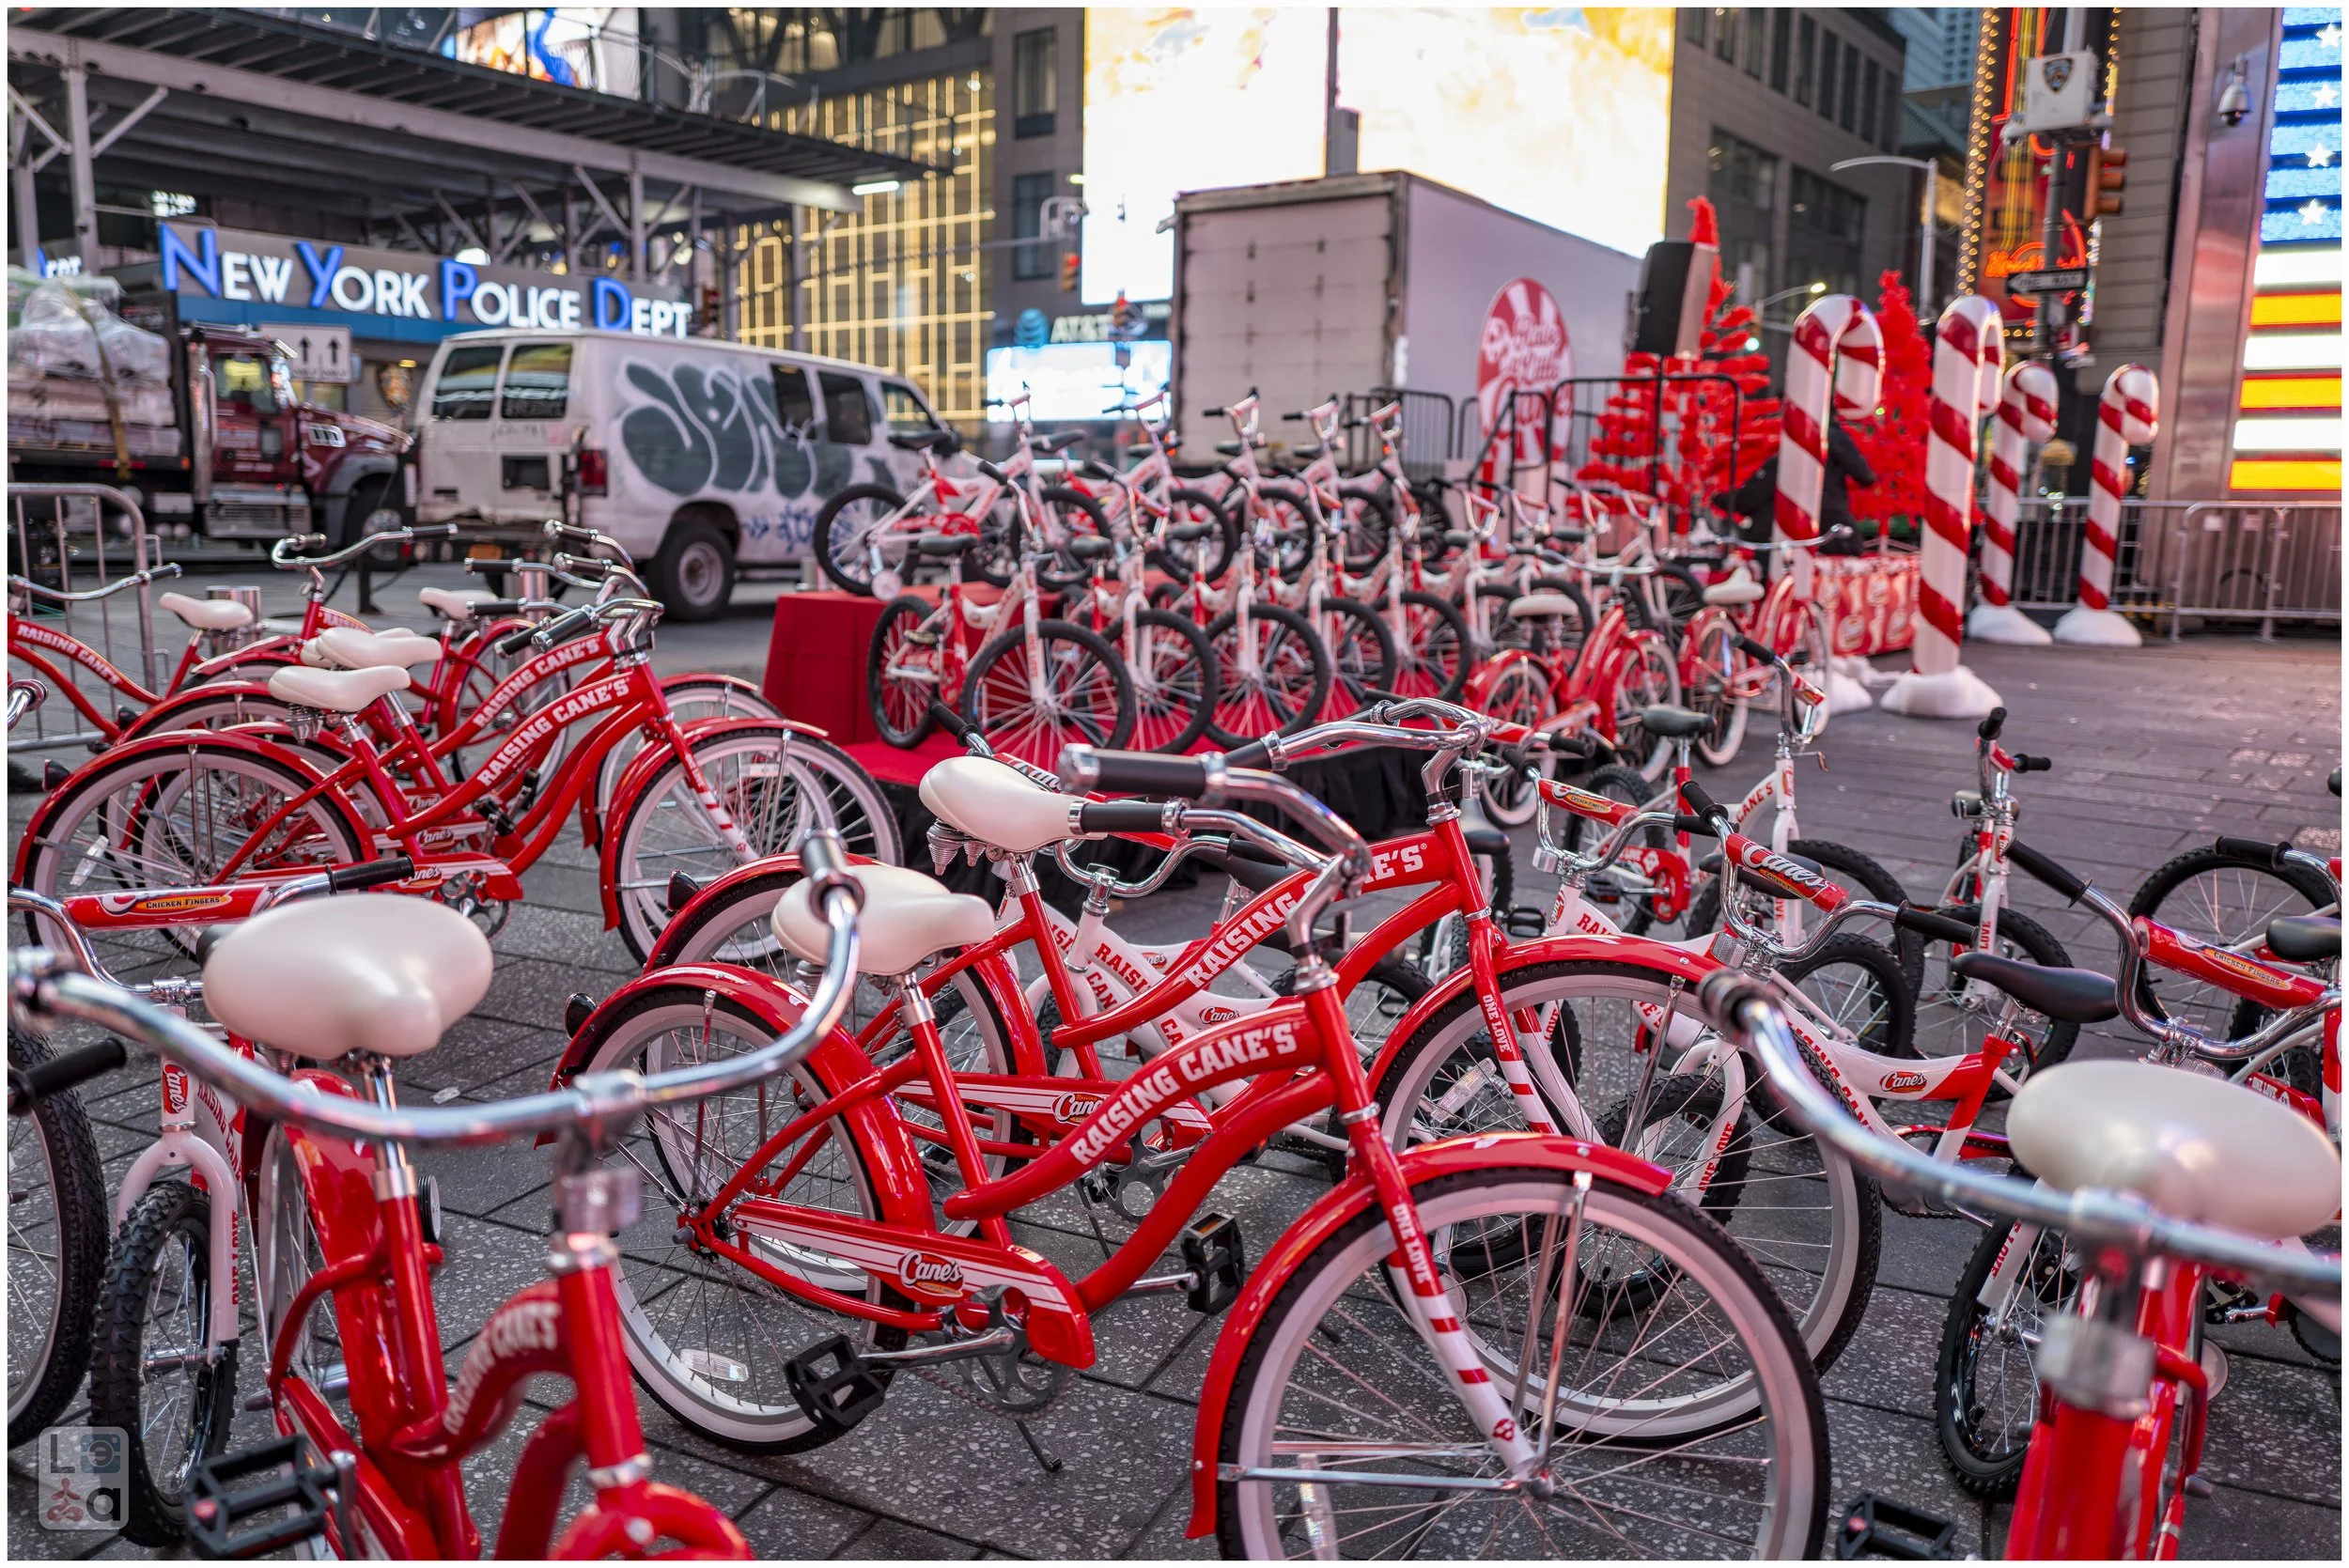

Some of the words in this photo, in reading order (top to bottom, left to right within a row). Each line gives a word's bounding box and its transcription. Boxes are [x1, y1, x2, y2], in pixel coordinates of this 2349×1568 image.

[160, 221, 293, 303] NEW
[296, 241, 431, 318] YORK
[442, 259, 581, 330] POLICE
[594, 277, 692, 339] DEPT
[17, 624, 77, 655] RAISING
[473, 669, 537, 729] RAISING
[535, 636, 599, 674] CANE'S
[476, 716, 553, 787] RAISING
[552, 677, 630, 723] CANE'S
[146, 900, 182, 909] CHICKEN
[184, 896, 221, 907] FINGERS
[1185, 893, 1299, 988] RAISING
[1980, 922, 1991, 951] LOVE
[2213, 951, 2247, 970] CHICKEN
[2248, 966, 2281, 986] FINGERS
[1086, 971, 1117, 1009] CAN
[1482, 993, 1498, 1021] ONE
[1490, 1017, 1512, 1053] LOVE
[1070, 1066, 1180, 1165] RAISING
[1178, 1022, 1297, 1082] CANE'S
[1881, 1071, 1927, 1093] Cane's
[1713, 1121, 1735, 1159] OVE
[1392, 1203, 1417, 1240] ONE
[1405, 1236, 1432, 1284] LOVE
[900, 1250, 964, 1286] Cane's
